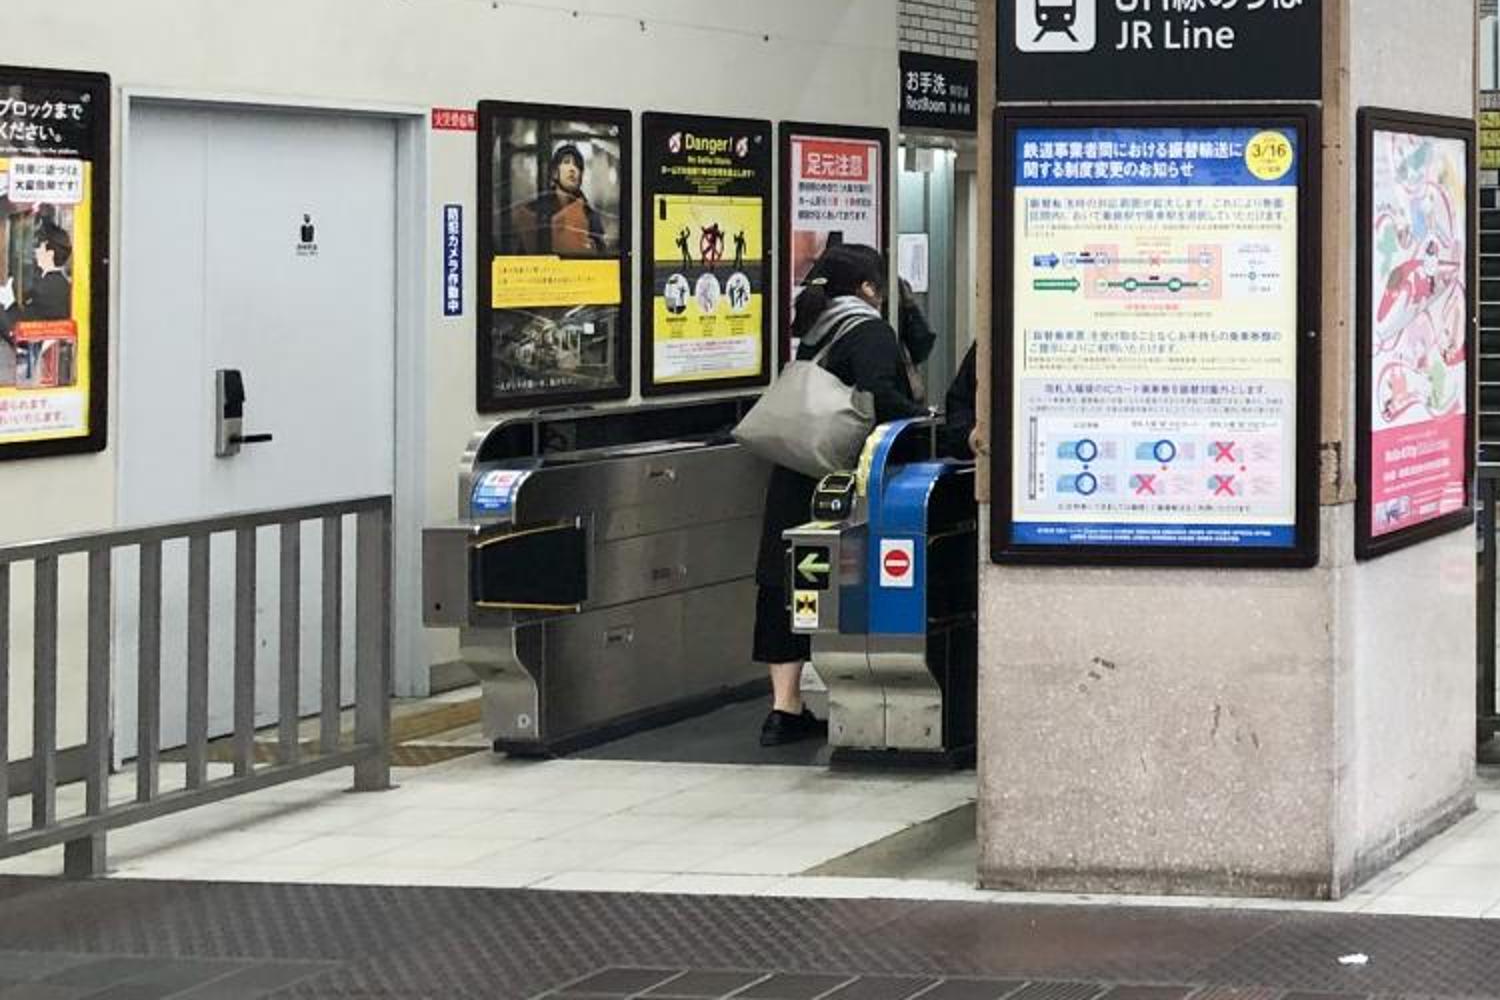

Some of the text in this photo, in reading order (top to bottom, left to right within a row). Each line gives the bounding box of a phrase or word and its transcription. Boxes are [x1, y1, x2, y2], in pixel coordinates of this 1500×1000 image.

[1115, 19, 1235, 49] JR Line
[906, 71, 947, 95] お手洗
[684, 133, 733, 155] Danger!
[1251, 144, 1286, 157] 3/16
[807, 152, 864, 177] 足元注意
